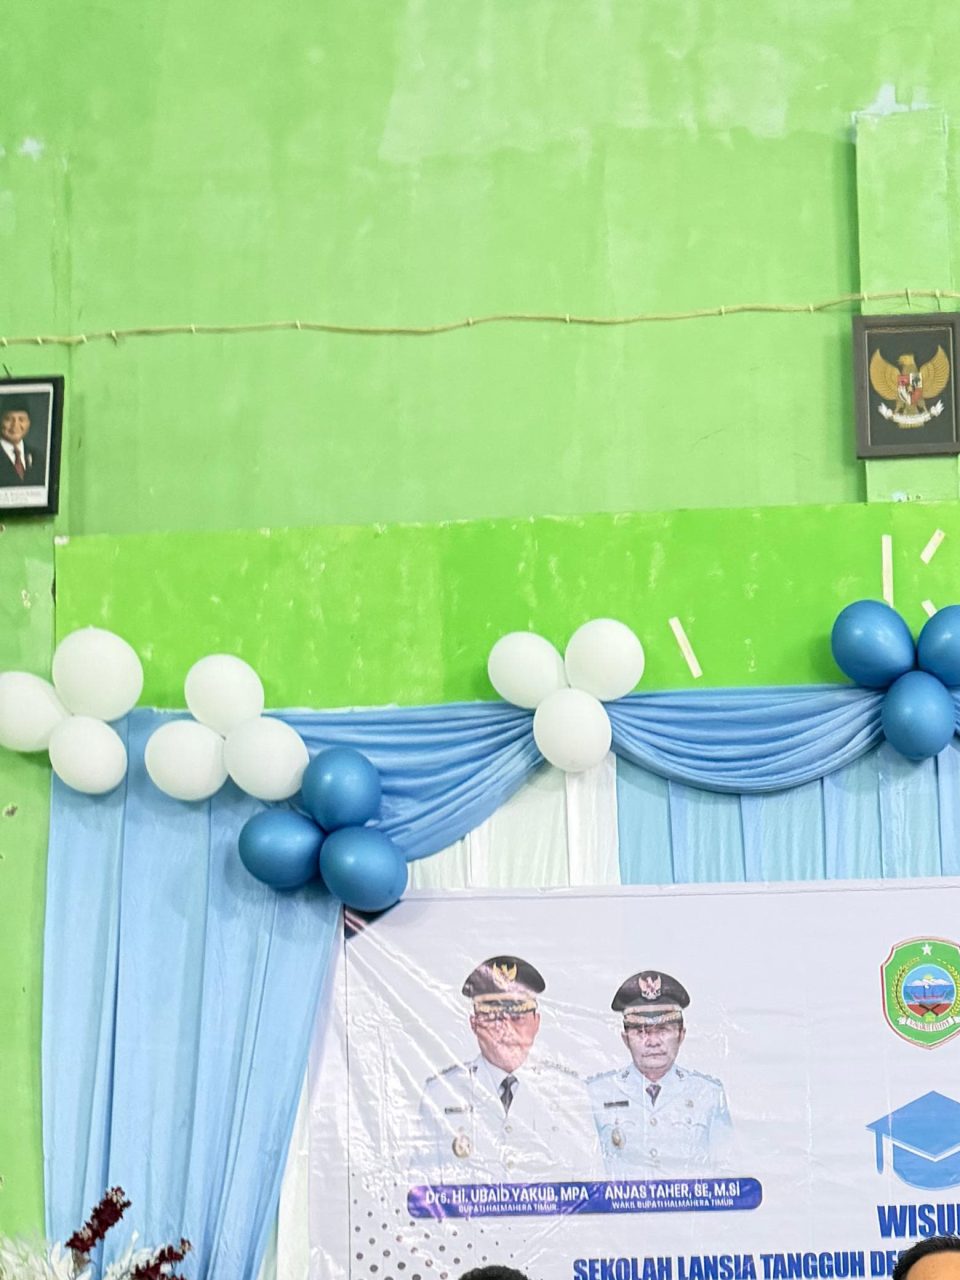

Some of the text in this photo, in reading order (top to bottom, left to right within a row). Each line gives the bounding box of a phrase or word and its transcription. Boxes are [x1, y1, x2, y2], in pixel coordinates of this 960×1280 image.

[470, 1187, 510, 1203] UBAID
[560, 1186, 589, 1200] MPA
[605, 1184, 646, 1200] ANJAS
[649, 1183, 692, 1199] TAHER,
[760, 1251, 865, 1280] TANGGUH
